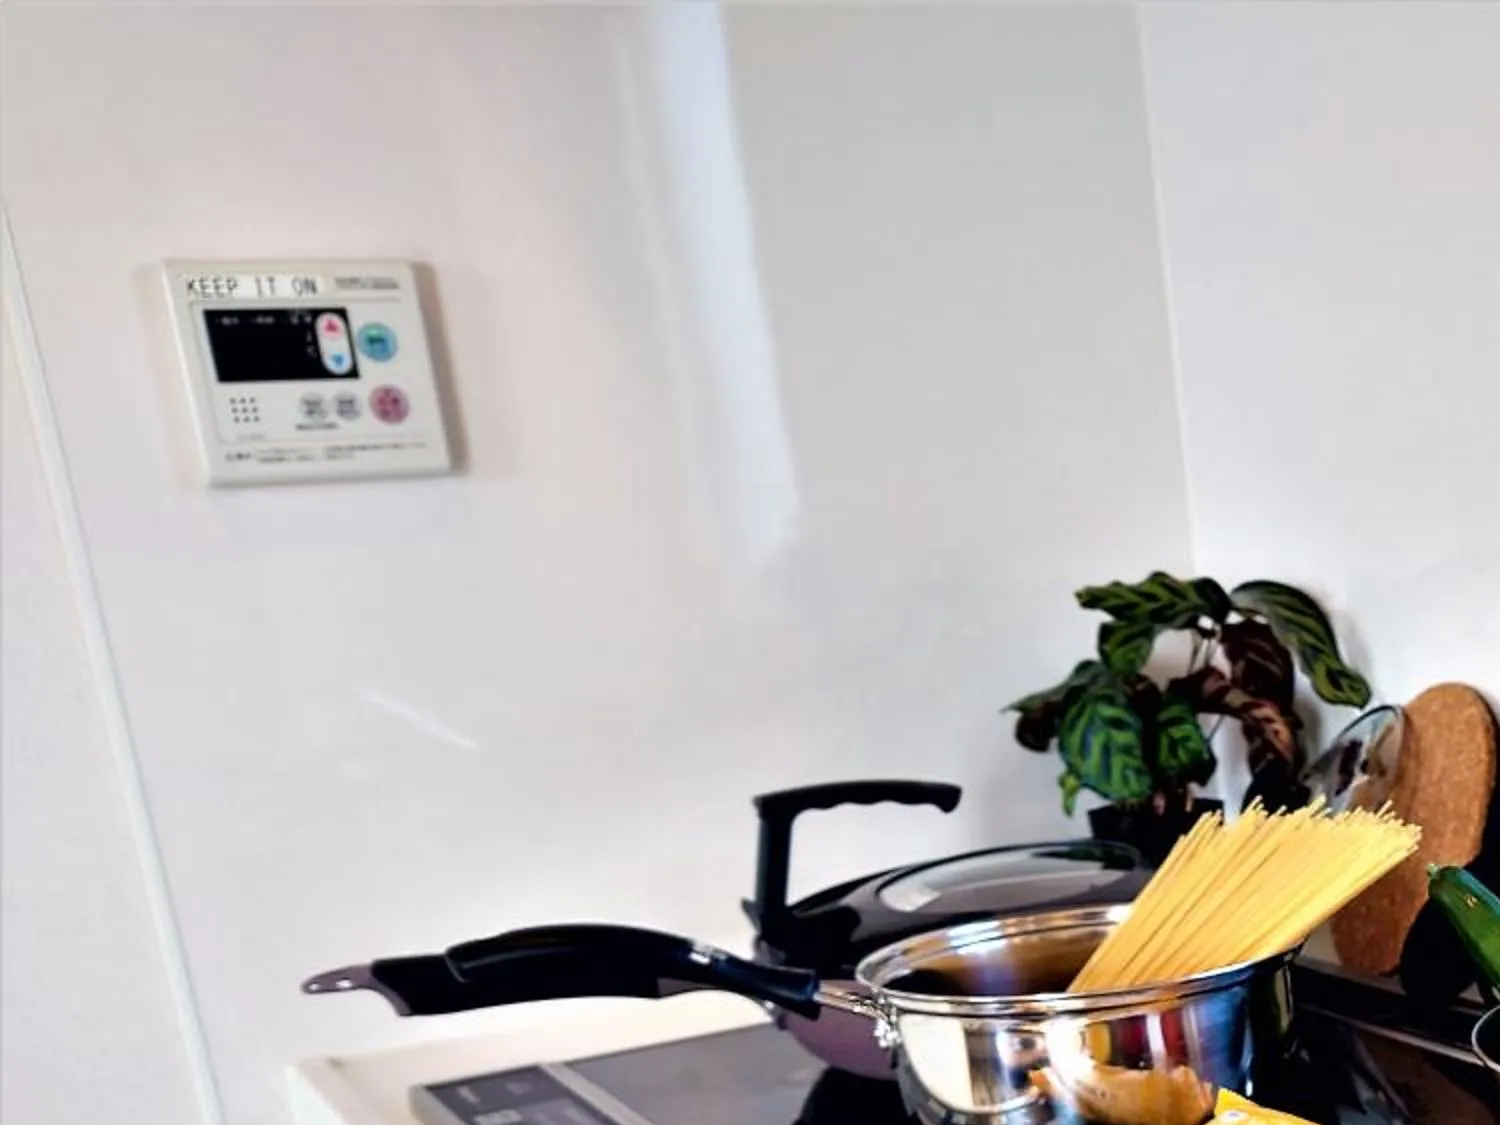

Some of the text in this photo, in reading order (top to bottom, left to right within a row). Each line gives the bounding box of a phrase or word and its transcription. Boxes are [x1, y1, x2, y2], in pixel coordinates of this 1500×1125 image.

[187, 277, 238, 298] KEEP
[255, 277, 276, 298] IT
[292, 277, 318, 297] ON
